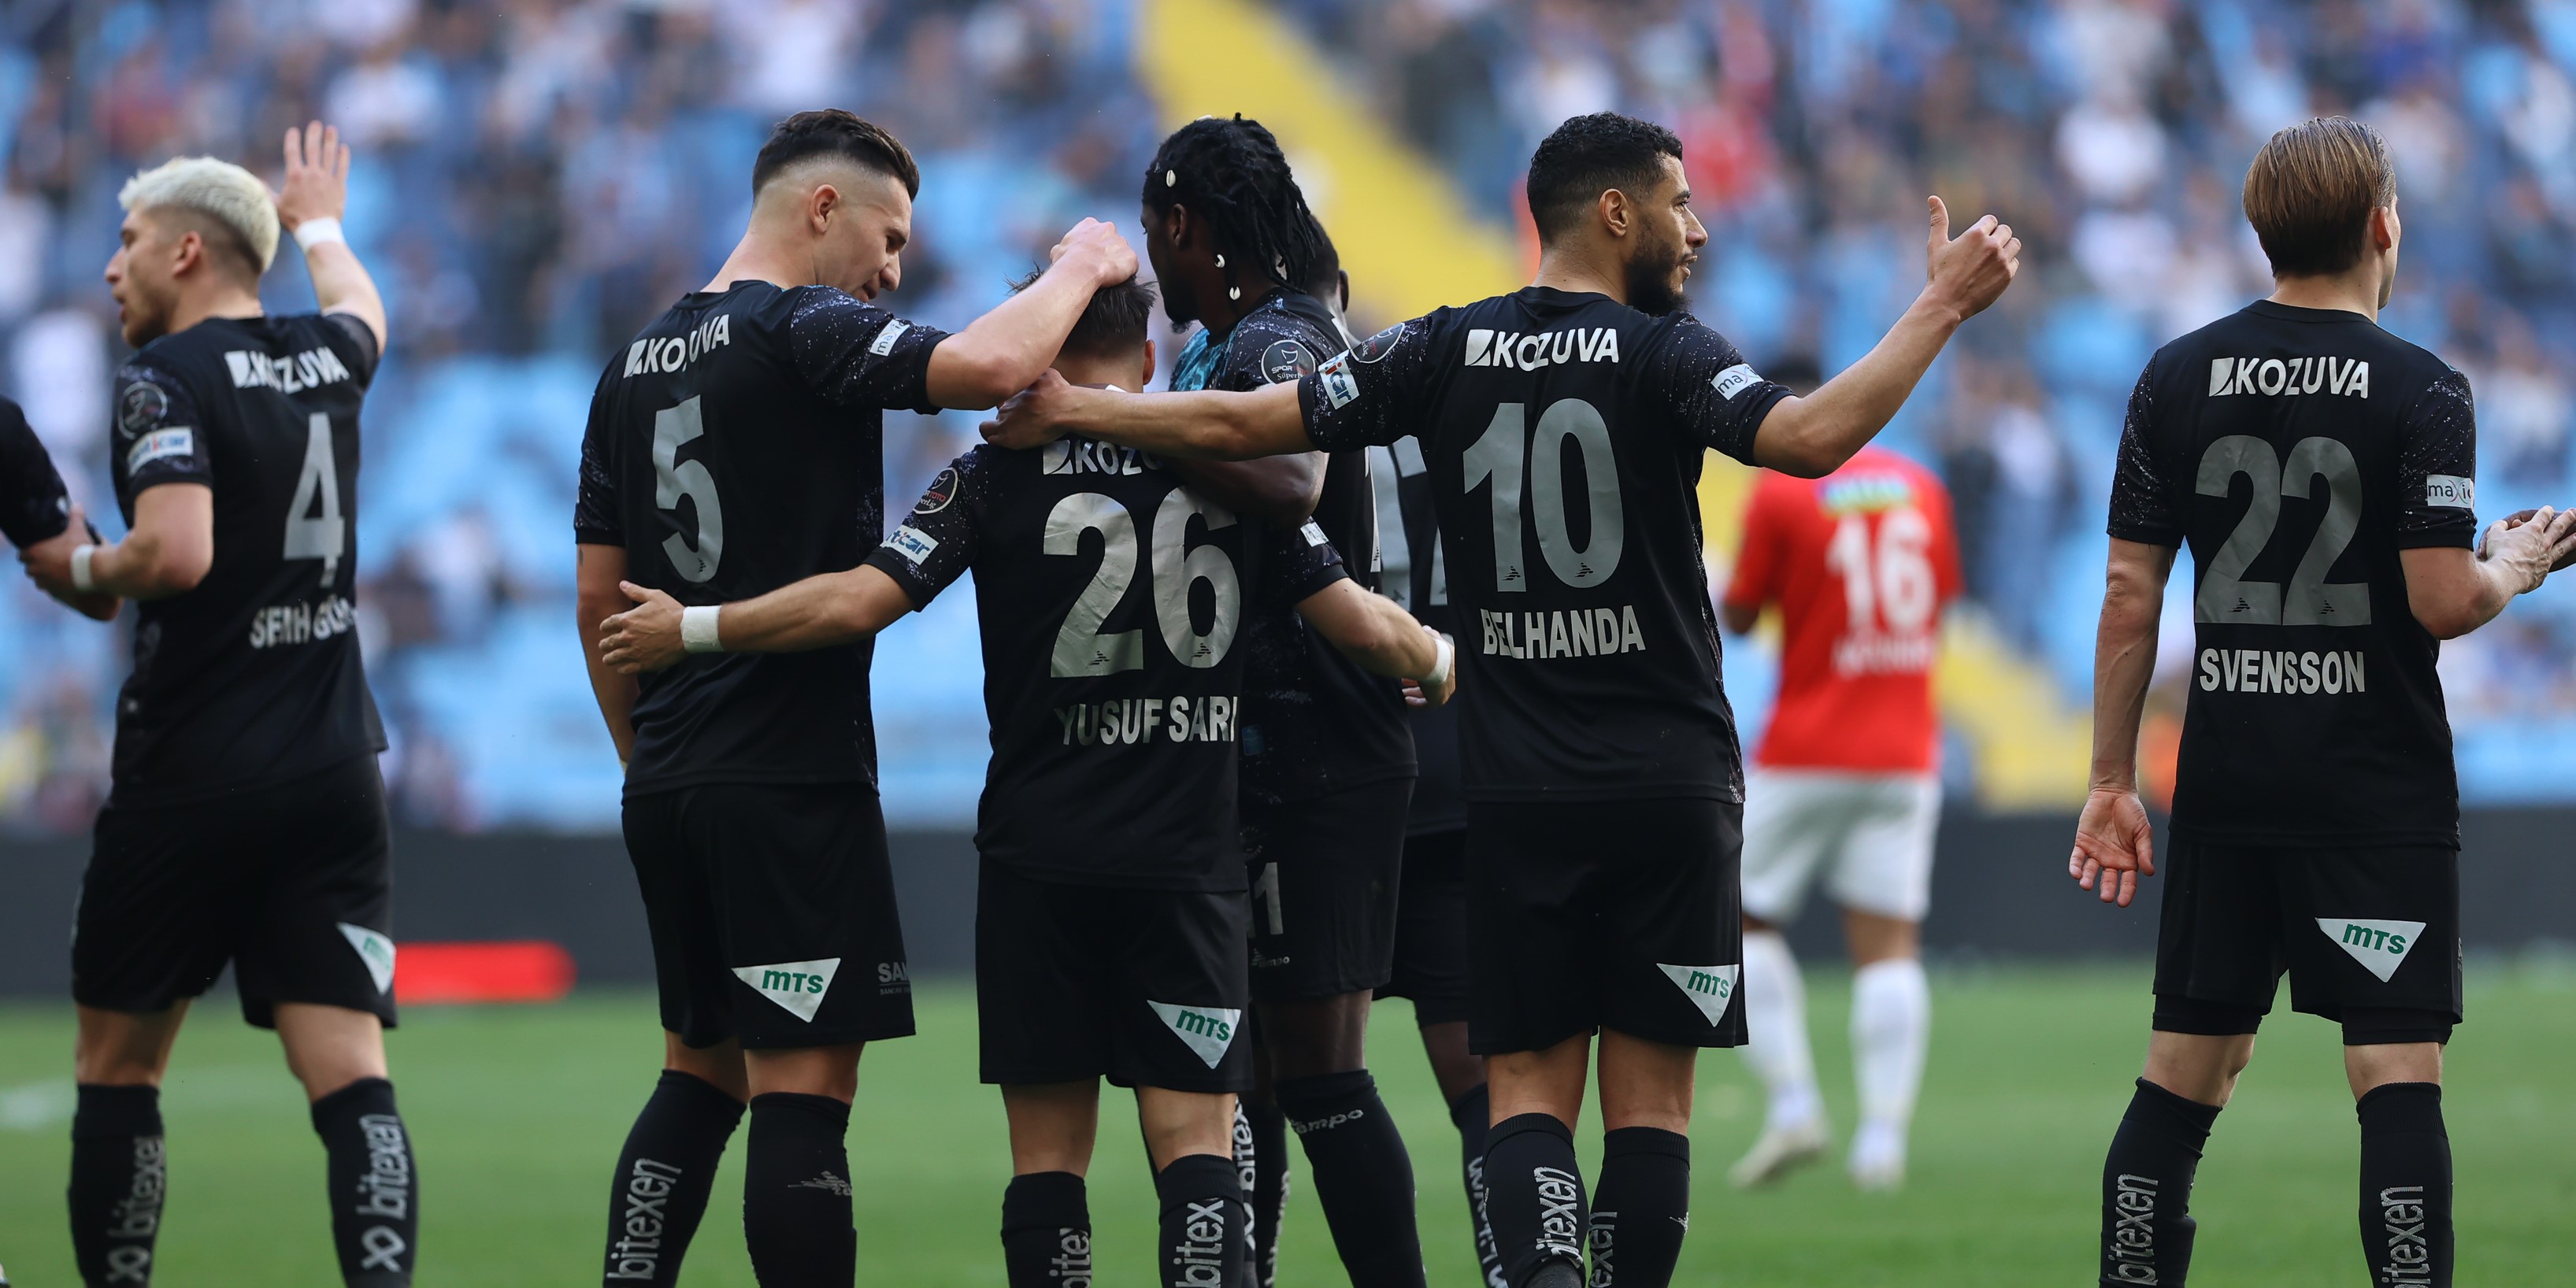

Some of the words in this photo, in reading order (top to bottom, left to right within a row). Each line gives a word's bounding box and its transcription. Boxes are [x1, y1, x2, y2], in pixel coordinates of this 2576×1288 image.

[1493, 328, 1620, 372] KOZUVA
[2235, 356, 2370, 399] KOZUVA
[284, 412, 346, 587] 4
[652, 394, 724, 583] 5
[1462, 398, 1624, 593] 10
[2194, 435, 2372, 627] 22
[1043, 485, 1241, 679] 26
[1825, 506, 1937, 631] 16
[1480, 605, 1646, 659] BELHANDA
[2200, 649, 2365, 694] SVENSSON
[1054, 698, 1163, 746] YUSUF
[606, 1157, 683, 1281] bitexen
[2107, 1173, 2159, 1288] bitexen
